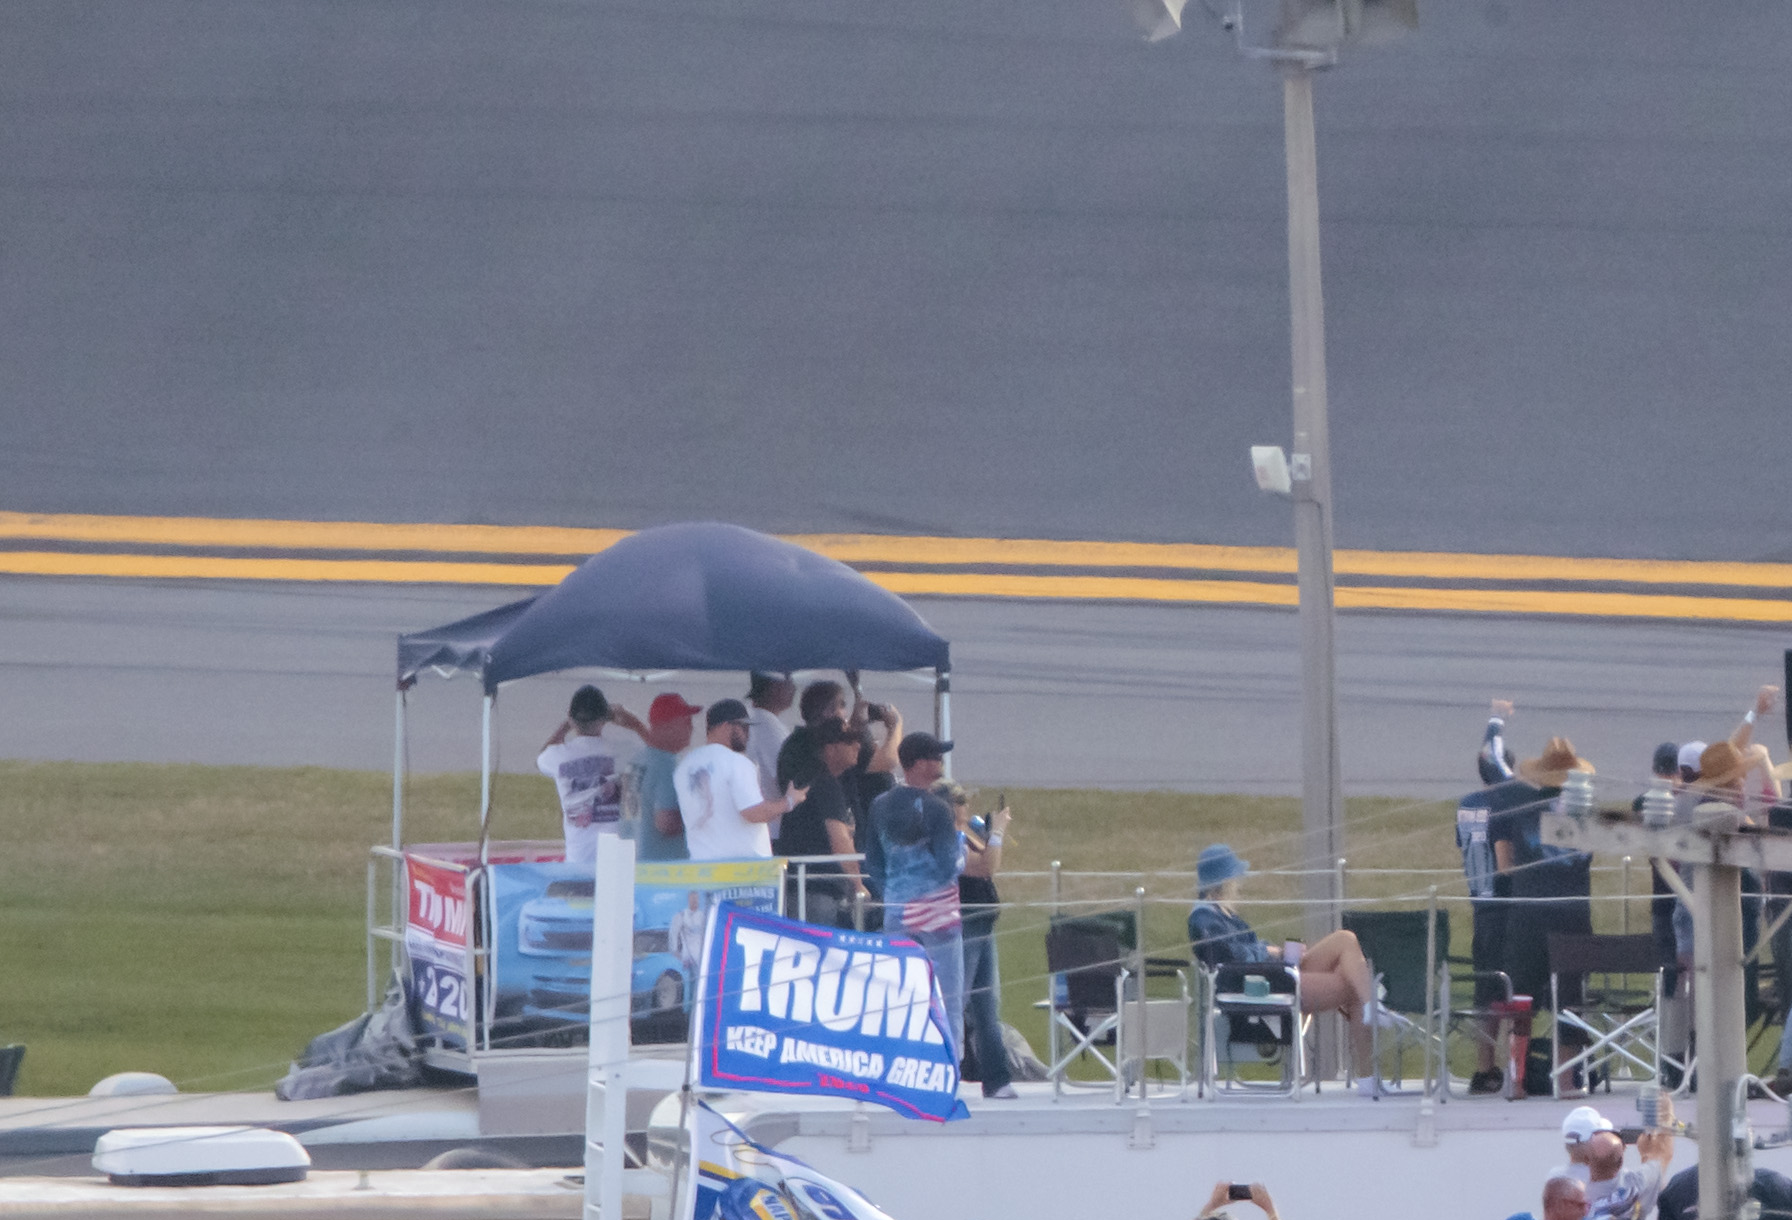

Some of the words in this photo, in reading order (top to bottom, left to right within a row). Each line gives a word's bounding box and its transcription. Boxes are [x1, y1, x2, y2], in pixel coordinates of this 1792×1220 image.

[736, 926, 944, 1045] TRUM
[726, 1025, 777, 1059] KEEP
[780, 1037, 884, 1079] AMERICA
[886, 1056, 955, 1093] GREAT
